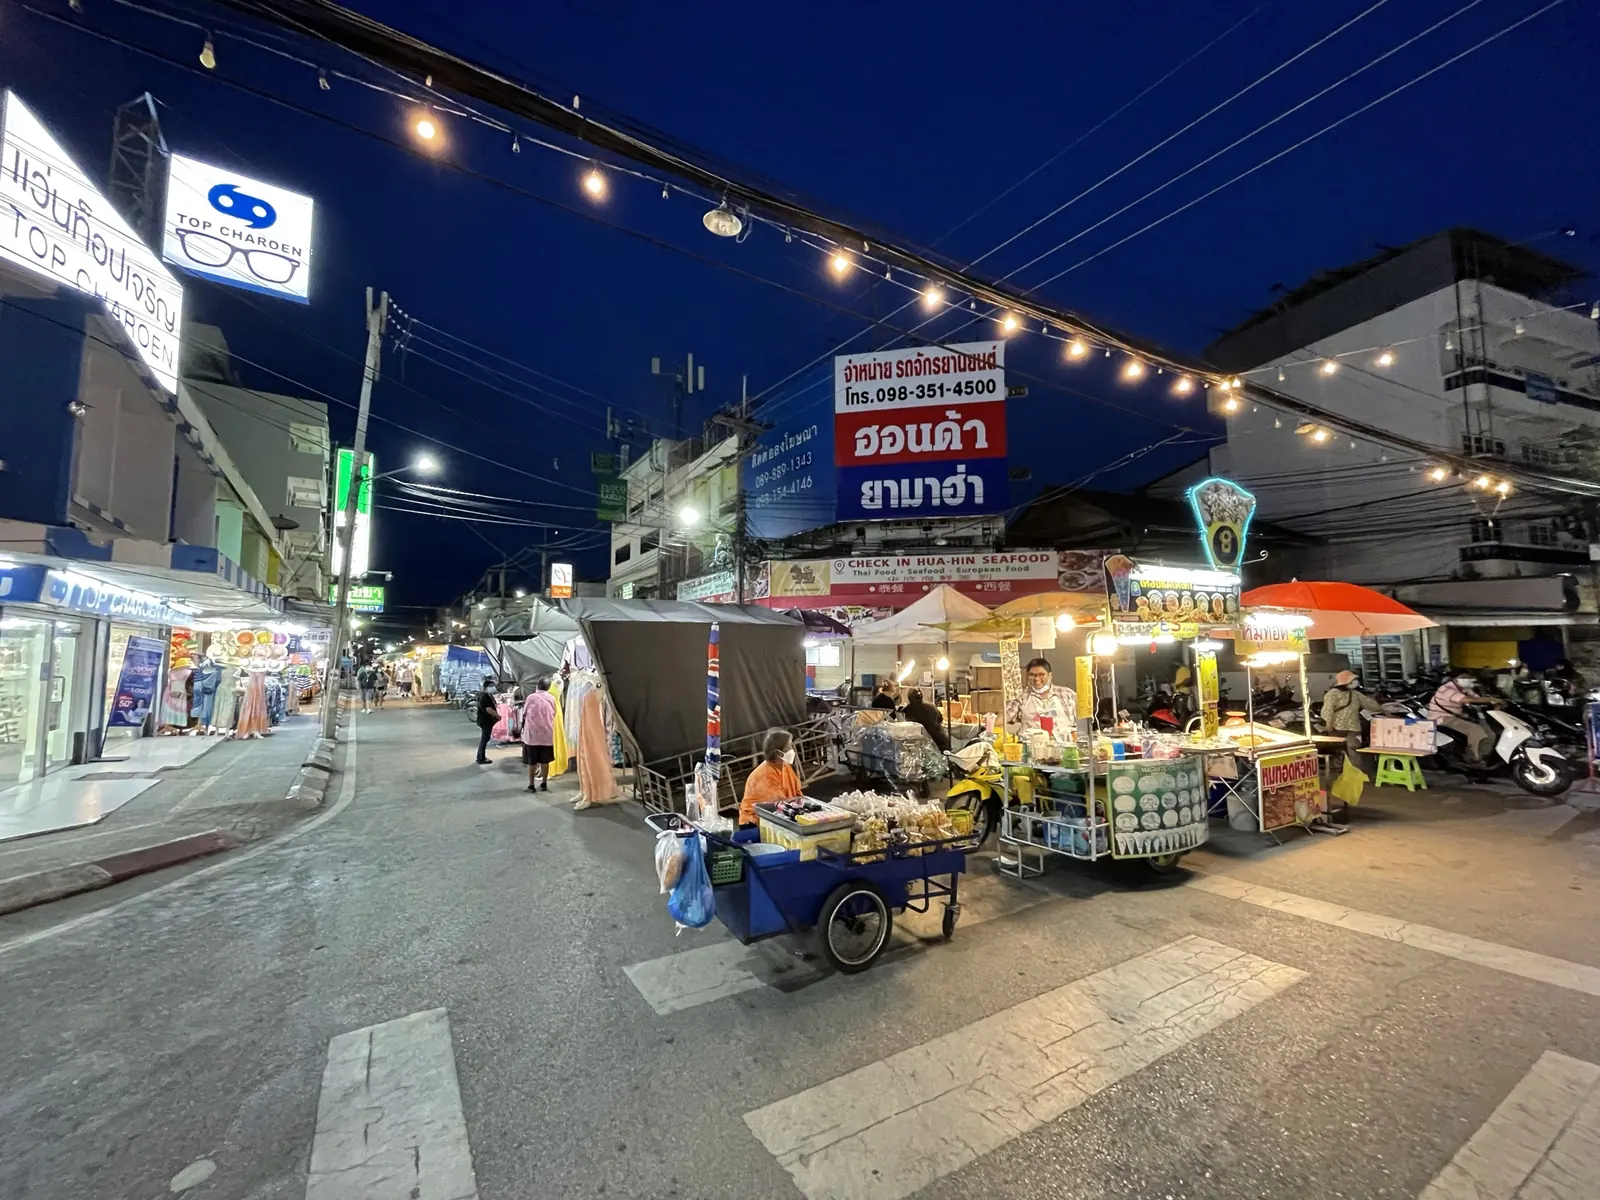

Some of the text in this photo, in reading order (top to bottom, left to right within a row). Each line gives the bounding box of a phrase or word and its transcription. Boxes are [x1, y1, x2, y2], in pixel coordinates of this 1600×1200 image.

[9, 203, 67, 269] TOP
[13, 149, 176, 333] แว่นท็อปเจริญ
[177, 213, 302, 257] TOP CHAROEN
[844, 345, 997, 383] จำหน่าย รถจักรยานยนต์
[854, 410, 988, 456] ฮอนด้า
[861, 464, 984, 509] ยามาฮ่า
[848, 554, 1050, 568] CHECK IN HUA-HIN SEAFOOD
[875, 568, 897, 576] Food
[907, 567, 945, 575] Seafood
[956, 567, 1001, 575] European
[74, 584, 108, 610] TOP
